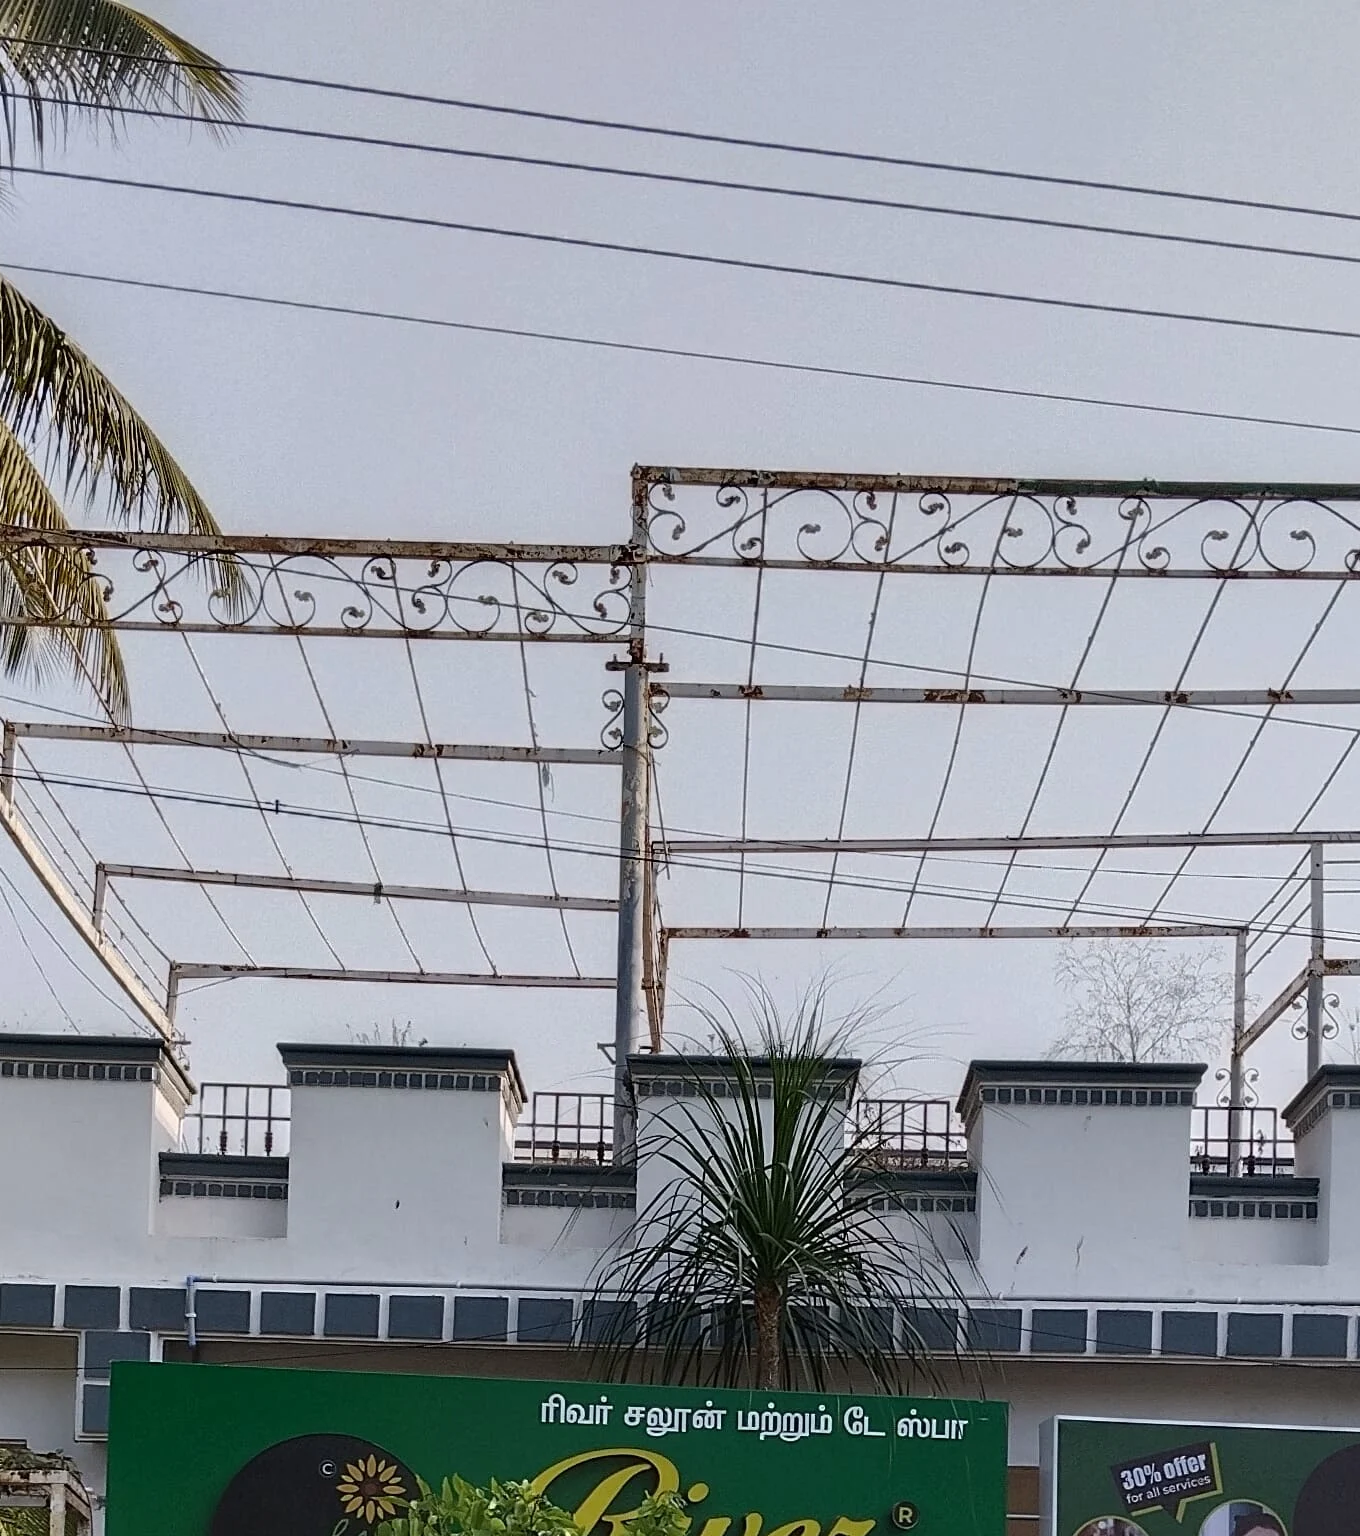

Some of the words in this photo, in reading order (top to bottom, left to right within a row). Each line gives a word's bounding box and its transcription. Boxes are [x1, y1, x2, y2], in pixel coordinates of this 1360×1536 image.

[540, 1394, 613, 1425] ரிவர்
[624, 1401, 727, 1437] சலூன்
[738, 1403, 833, 1442] மற்றும்
[844, 1406, 885, 1437] டே
[897, 1409, 968, 1440] ஸ்பா
[1120, 1463, 1162, 1490] 30%
[1163, 1453, 1206, 1479] offer
[1126, 1493, 1143, 1504] for
[1146, 1487, 1160, 1499] all
[1162, 1476, 1211, 1495] services
